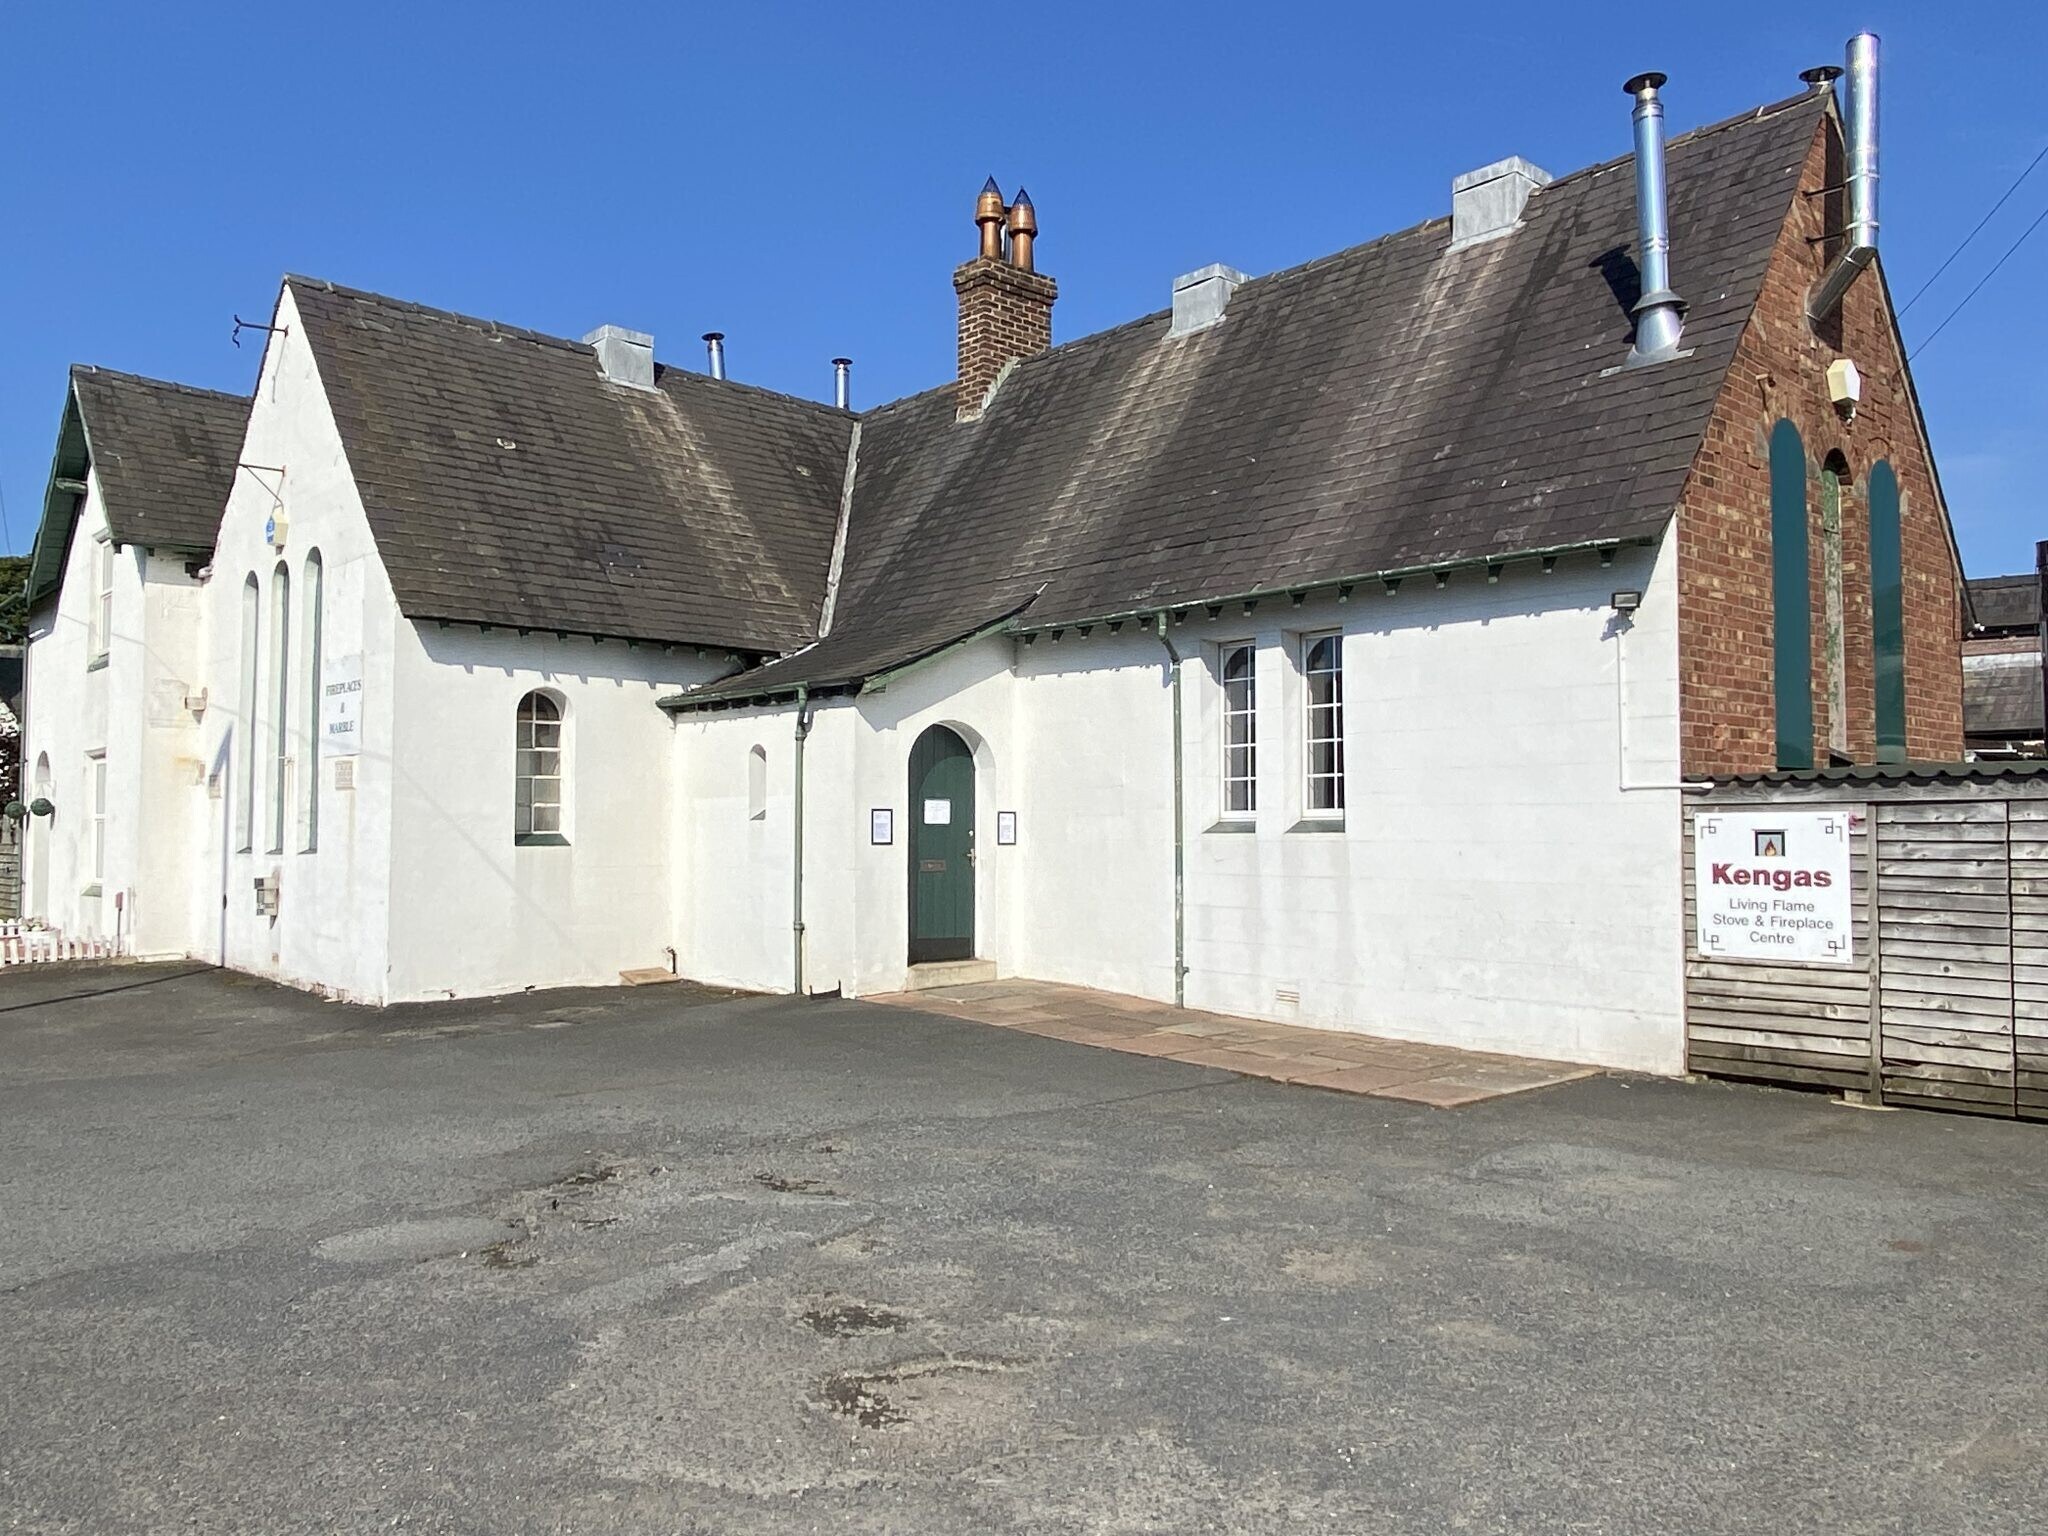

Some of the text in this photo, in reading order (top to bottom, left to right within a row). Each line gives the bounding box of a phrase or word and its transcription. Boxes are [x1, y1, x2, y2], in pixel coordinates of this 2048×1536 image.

[326, 679, 362, 696] FIREPLACES
[329, 720, 354, 734] MARBLE
[1712, 863, 1832, 891] Kengas
[1729, 898, 1815, 912] Living Flame
[1713, 914, 1833, 930] Stove & Fireplace
[1750, 931, 1795, 944] Centre
